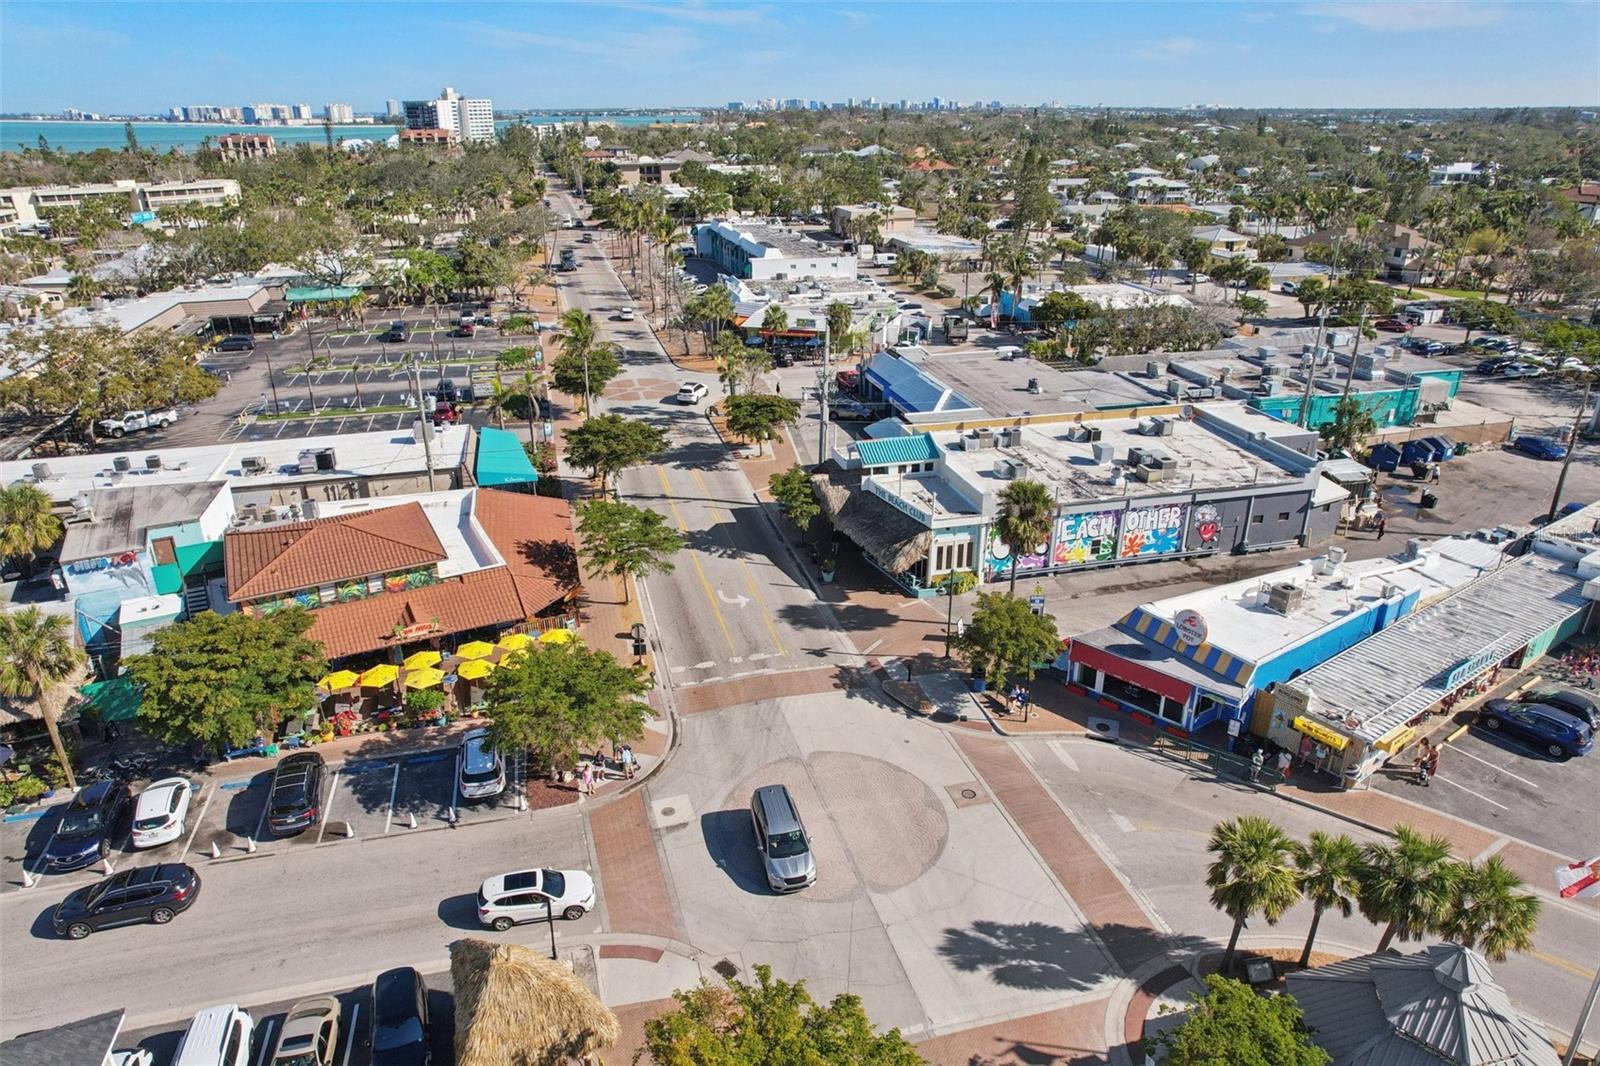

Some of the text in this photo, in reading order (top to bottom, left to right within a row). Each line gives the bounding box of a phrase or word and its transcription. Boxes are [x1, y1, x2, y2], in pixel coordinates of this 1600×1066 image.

[875, 486, 926, 522] THE BEACH CLUB
[1061, 506, 1181, 541] EACH OTHER
[1176, 622, 1202, 638] LOBSTER
[1183, 634, 1194, 642] POT
